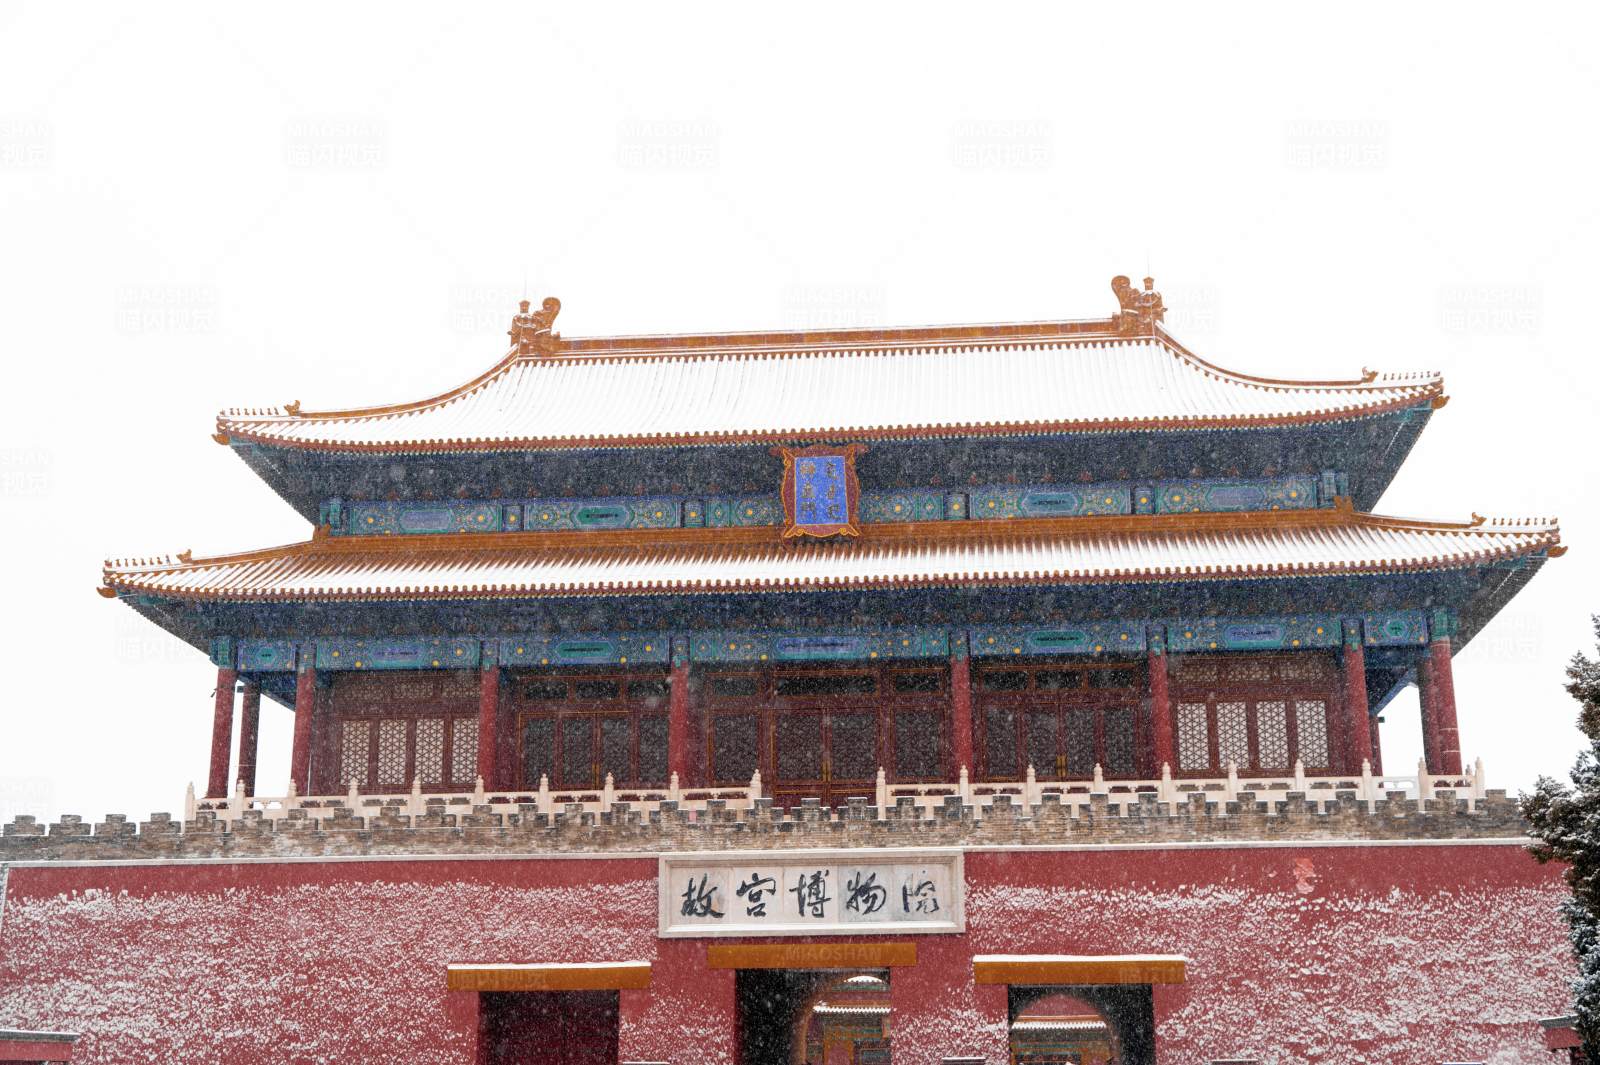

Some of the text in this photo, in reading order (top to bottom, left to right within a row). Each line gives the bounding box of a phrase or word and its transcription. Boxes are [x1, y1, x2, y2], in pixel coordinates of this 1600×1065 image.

[680, 869, 941, 919] 故宫博物院
